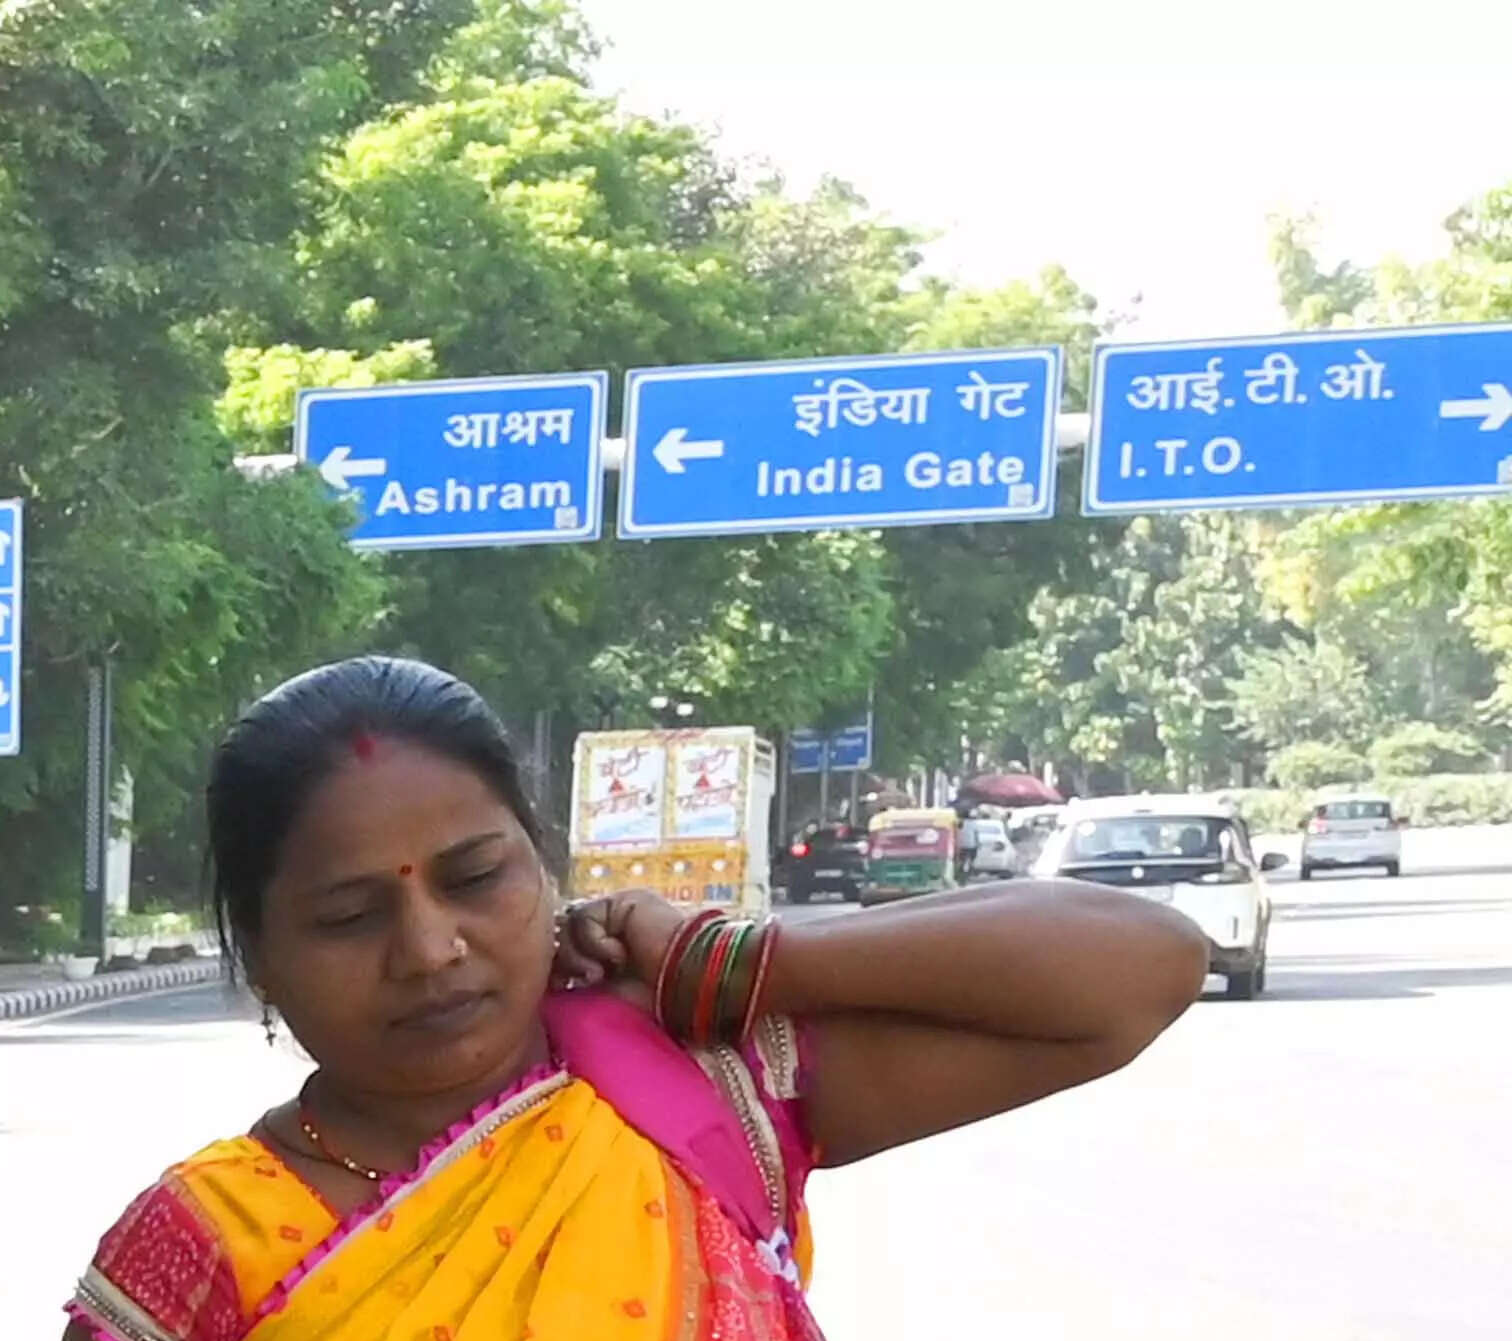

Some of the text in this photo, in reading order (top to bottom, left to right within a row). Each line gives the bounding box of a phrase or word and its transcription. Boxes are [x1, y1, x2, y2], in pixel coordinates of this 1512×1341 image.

[1126, 348, 1395, 414] आई. टी. ओ.
[792, 370, 1030, 437] इंडिया गेट
[442, 408, 575, 449] आश्रम
[757, 450, 1025, 496] India Gate
[1119, 436, 1256, 479] I.T.O.
[375, 477, 571, 516] Ashram
